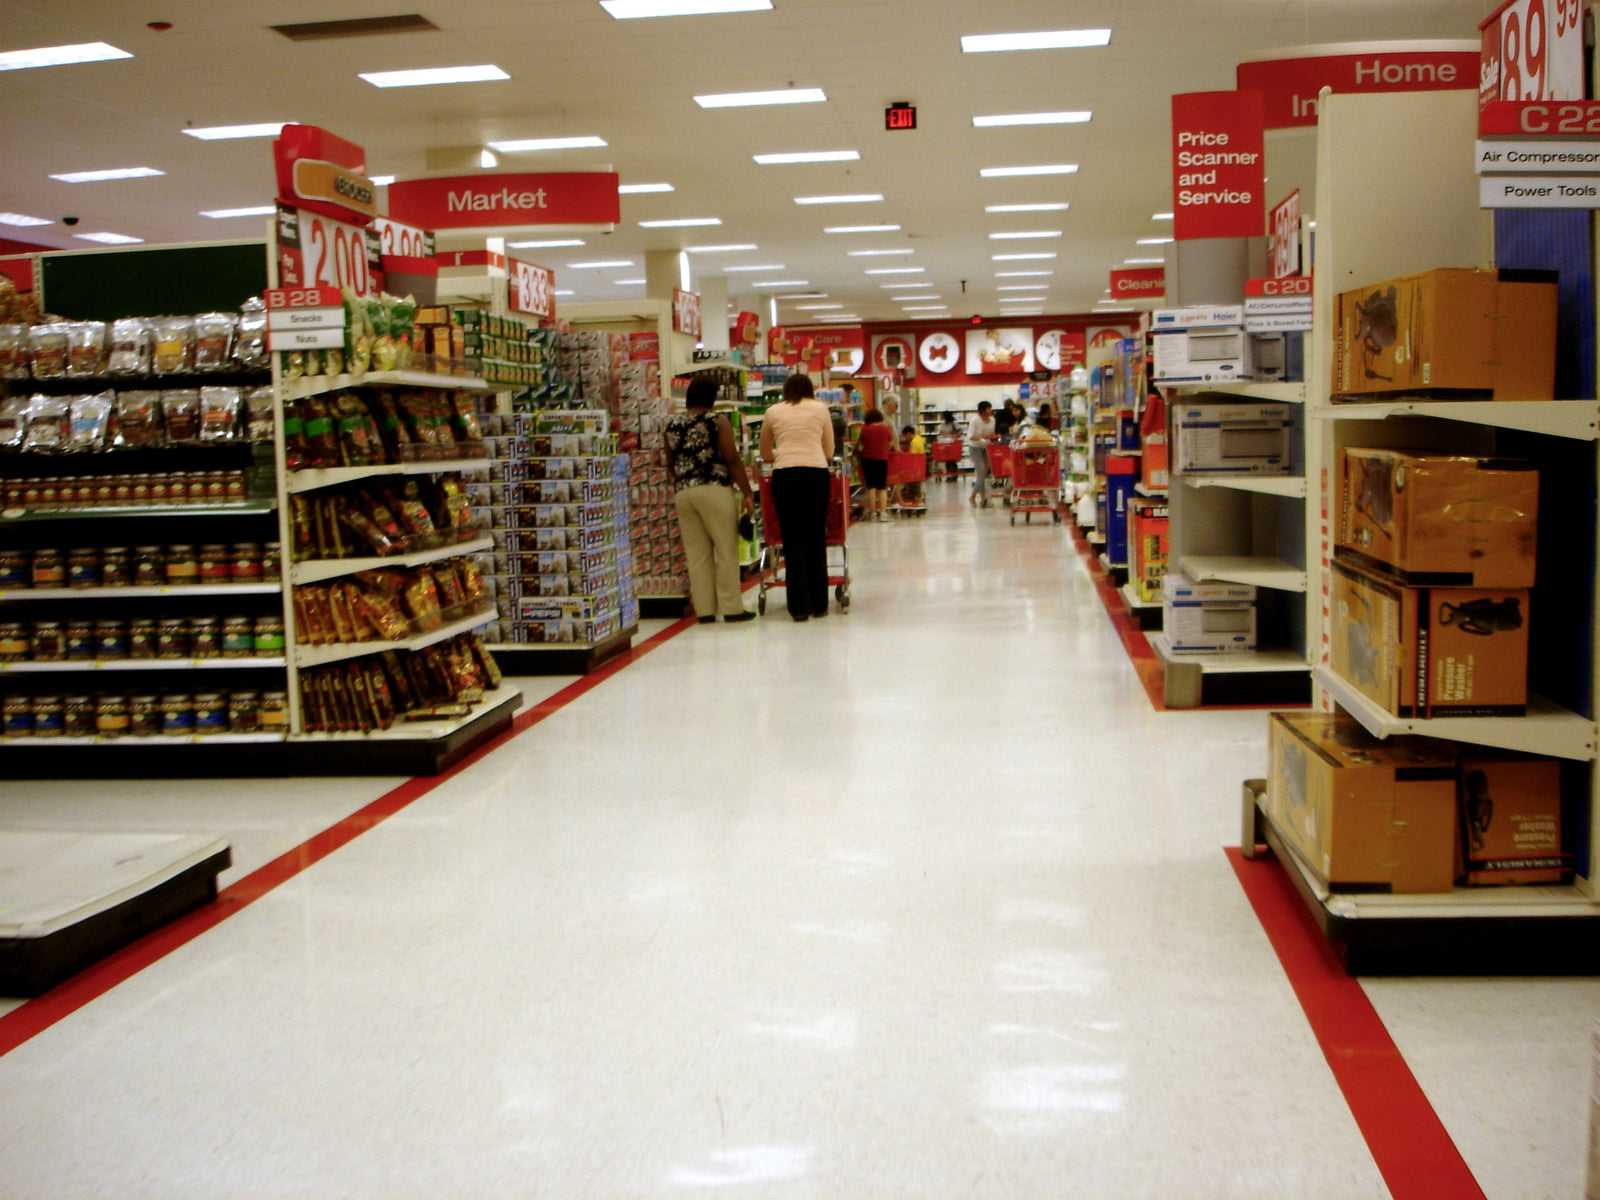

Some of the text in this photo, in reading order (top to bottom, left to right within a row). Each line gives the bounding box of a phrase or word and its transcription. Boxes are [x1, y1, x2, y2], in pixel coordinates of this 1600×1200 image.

[1355, 60, 1457, 84] Home
[889, 108, 913, 128] EXIT
[1521, 105, 1549, 133] C
[1178, 131, 1229, 147] Price
[1178, 151, 1258, 167] Scanner
[1482, 151, 1502, 162] Air
[1178, 169, 1216, 186] and
[1178, 188, 1252, 206] Service
[1504, 184, 1597, 197] Power Tools
[448, 187, 548, 212] Market
[1263, 279, 1310, 294] C 20
[269, 289, 321, 307] B 28
[289, 314, 323, 323] Snacks
[1213, 313, 1237, 321] Haier
[295, 334, 318, 343] Nuts
[814, 334, 842, 344] Care
[1443, 657, 1455, 700] Pressure
[1455, 663, 1465, 700] Washer
